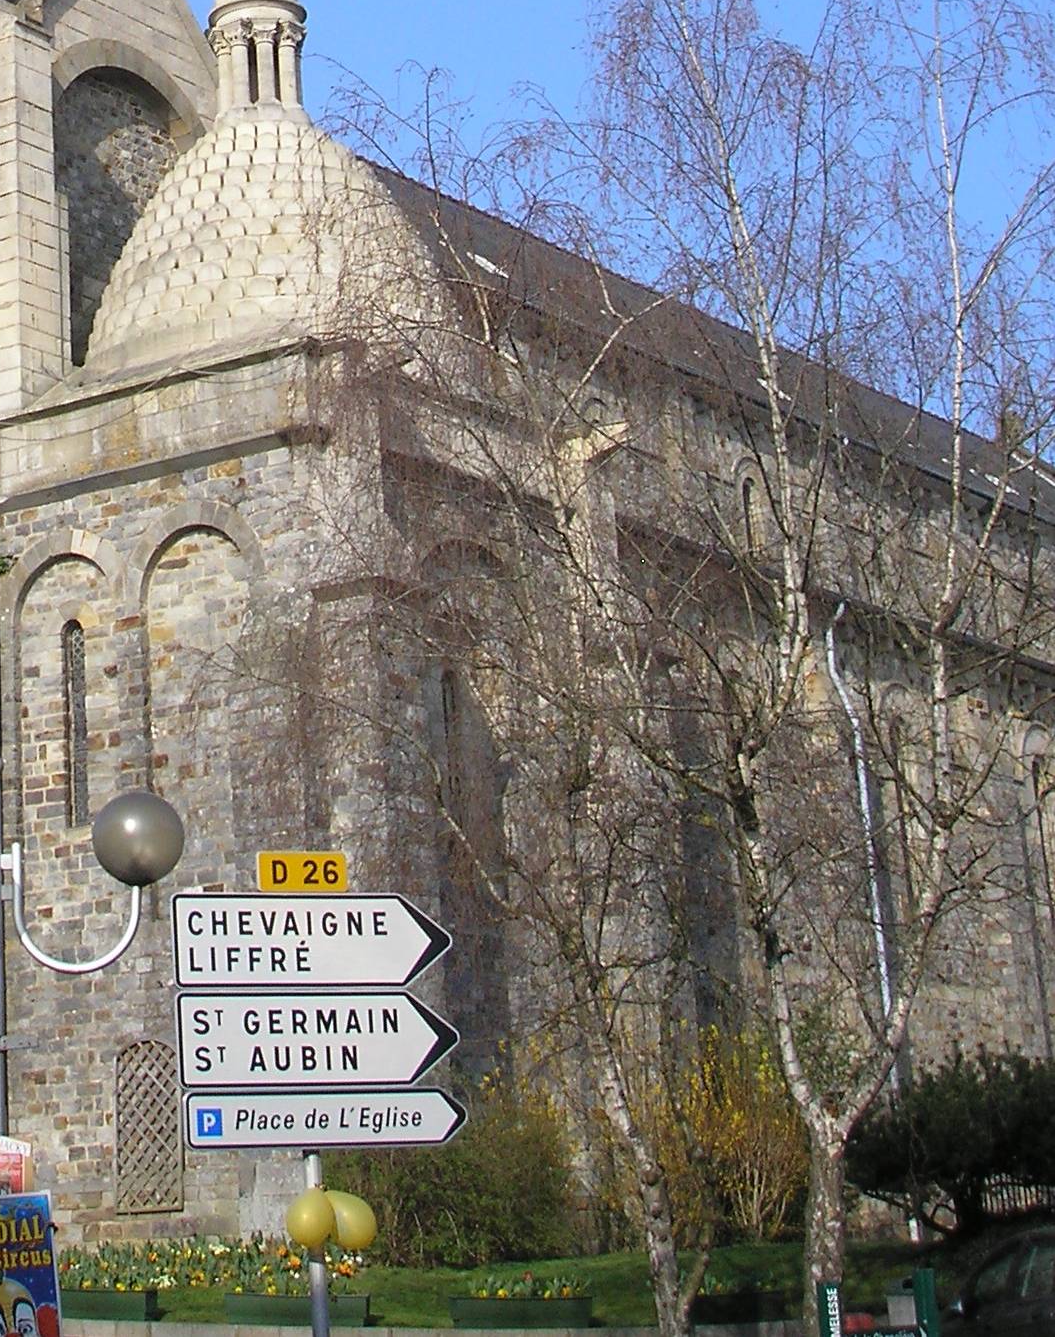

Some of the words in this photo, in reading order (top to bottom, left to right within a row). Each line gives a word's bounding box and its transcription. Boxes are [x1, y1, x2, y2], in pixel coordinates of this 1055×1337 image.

[272, 860, 288, 885] D
[303, 860, 340, 885] 26
[187, 910, 388, 937] CHEVAIGNE
[189, 940, 312, 972] LIFFRÉ
[244, 1008, 399, 1035] GERMAIN
[249, 1044, 359, 1072] AUBIN
[235, 1108, 295, 1131] Place
[304, 1107, 329, 1129] de
[339, 1106, 423, 1134] L'Eglise
[826, 1287, 840, 1337] MELESSE
